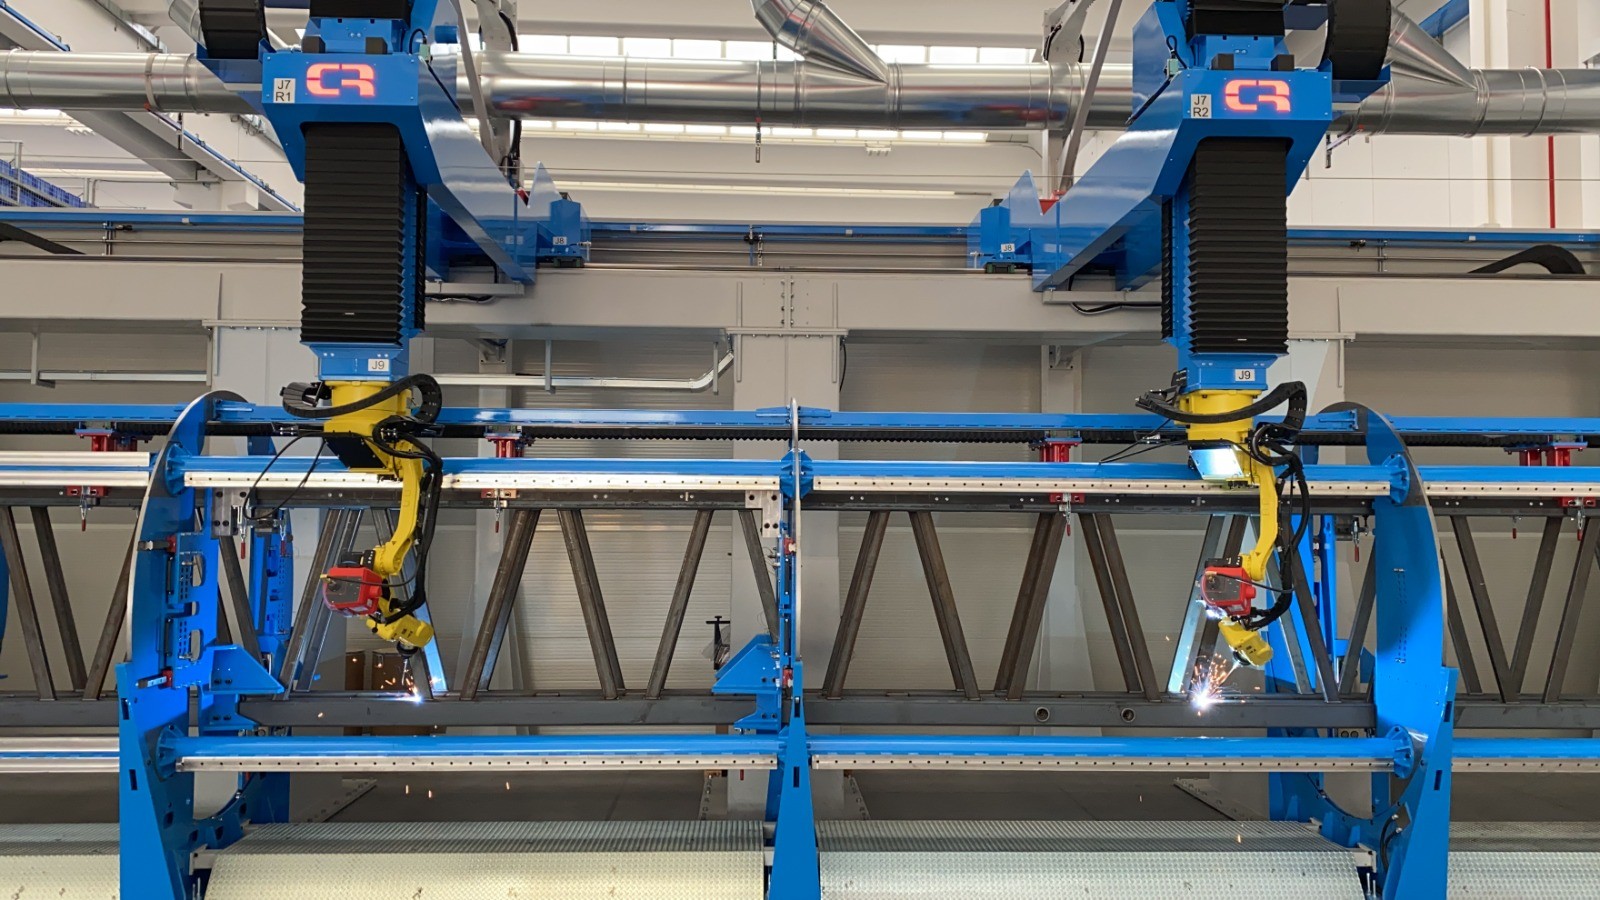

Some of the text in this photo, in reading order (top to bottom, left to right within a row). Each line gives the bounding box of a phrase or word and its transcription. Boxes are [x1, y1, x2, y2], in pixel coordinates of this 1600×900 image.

[277, 80, 291, 90] J7
[275, 91, 293, 102] R1
[1193, 95, 1207, 106] J7
[1193, 107, 1209, 118] R2
[371, 360, 385, 370] J9
[1238, 370, 1251, 380] J9
